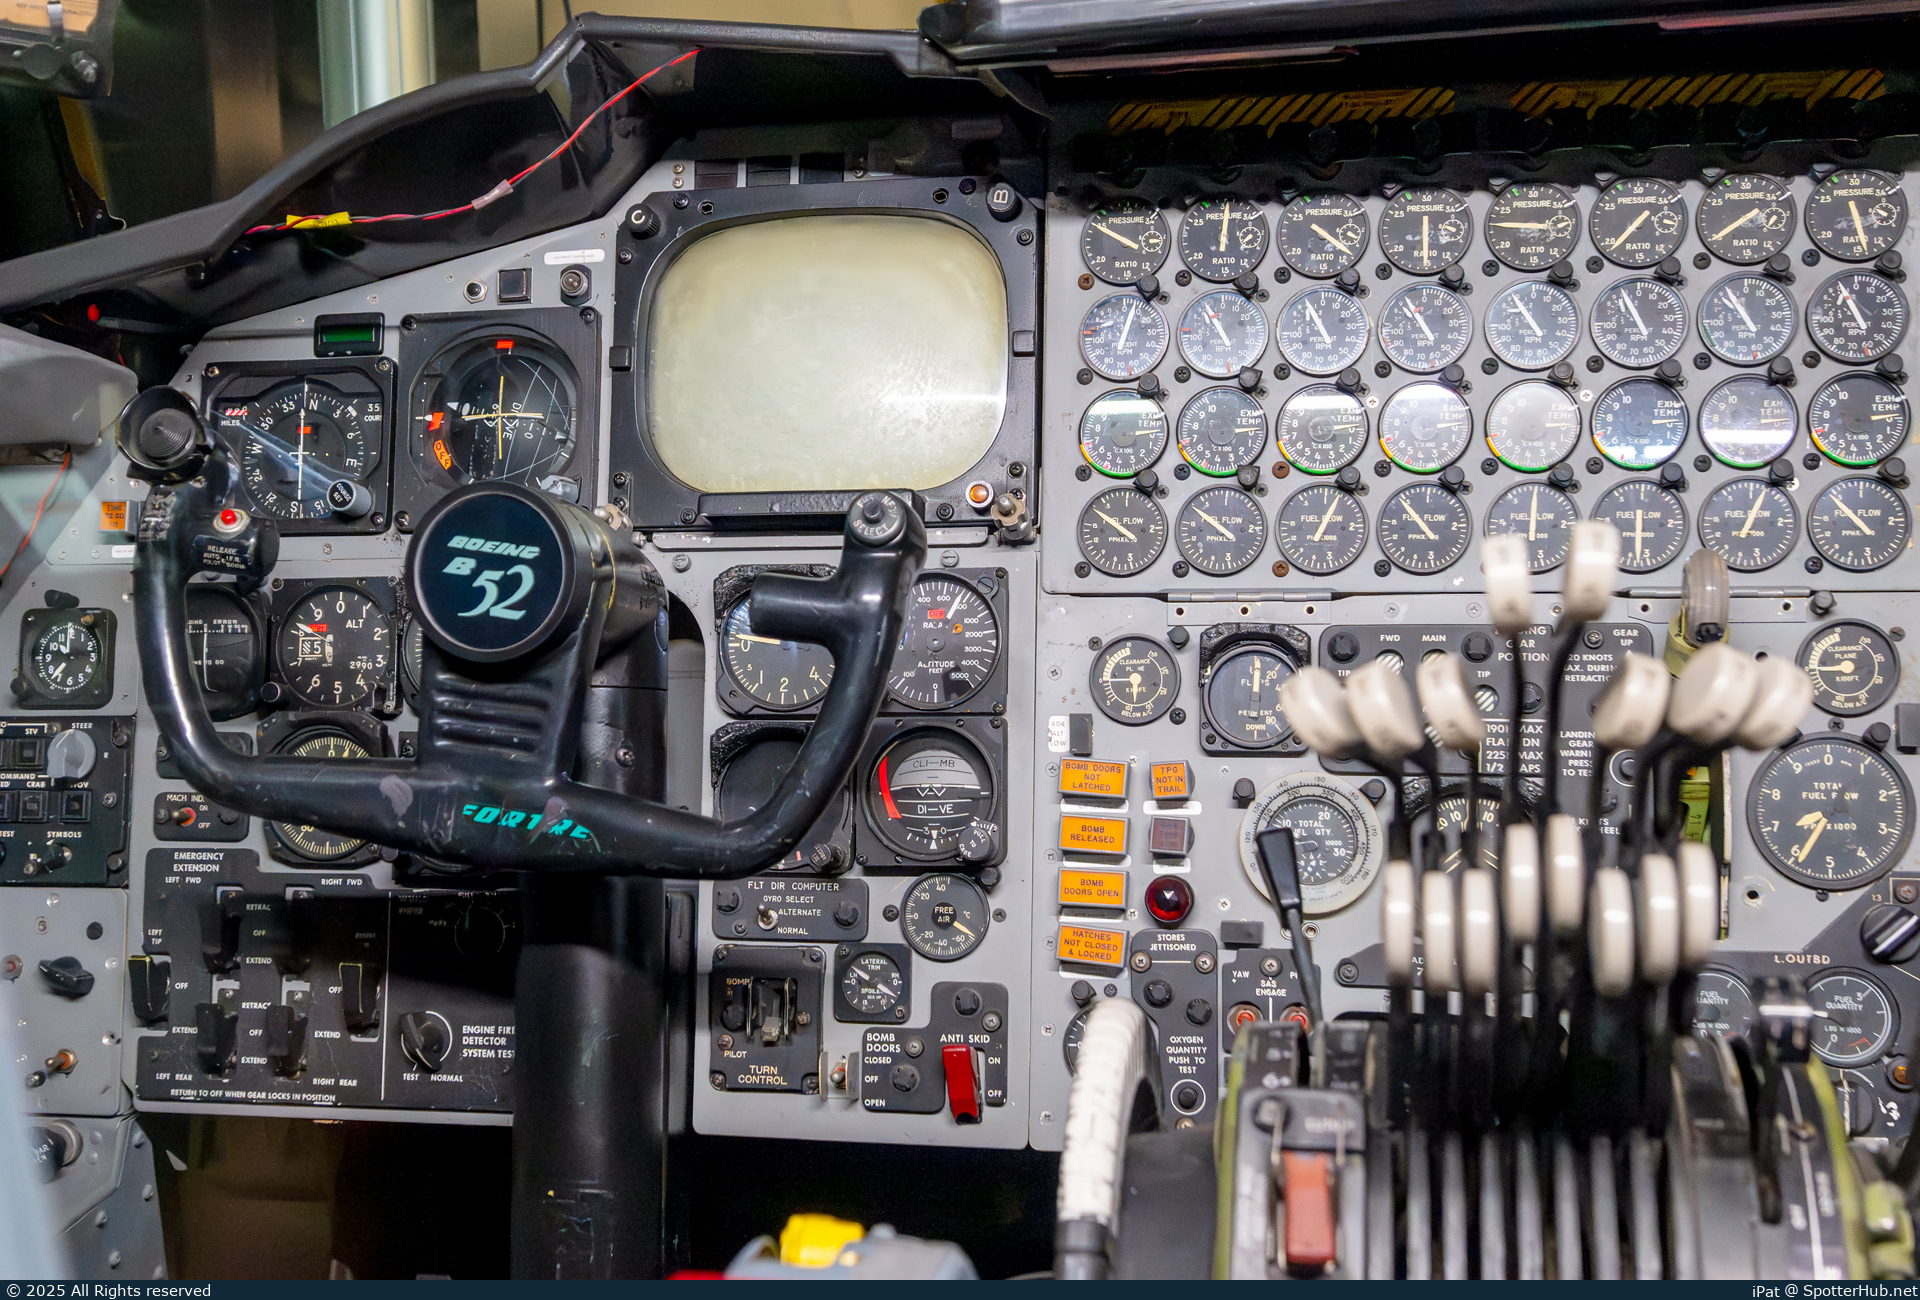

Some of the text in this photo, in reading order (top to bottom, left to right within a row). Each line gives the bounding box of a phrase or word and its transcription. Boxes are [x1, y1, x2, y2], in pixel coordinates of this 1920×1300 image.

[993, 188, 1009, 204] B
[1618, 196, 1657, 204] PRESSURE
[1725, 192, 1765, 200] PRESSURE
[1305, 208, 1342, 216] PRESSURE
[1406, 204, 1443, 213] PRESSURE
[631, 210, 645, 225] C
[1311, 253, 1334, 261] RATIO
[1525, 336, 1542, 344] RPM
[309, 400, 318, 410] N
[1872, 403, 1899, 411] TEMP
[252, 443, 263, 454] W
[434, 443, 452, 468] OFF
[335, 482, 351, 502] COURSE
[332, 493, 343, 503] SET
[290, 502, 299, 512] S
[1858, 509, 1881, 517] FLOW
[1124, 517, 1144, 525] FLOW
[447, 536, 540, 559] BOEING
[442, 556, 535, 621] B 52
[346, 619, 364, 629] ALT
[1613, 629, 1639, 637] GEAR
[964, 645, 982, 653] 3000
[1581, 654, 1613, 662] KNOTS
[1065, 762, 1121, 773] BOMB DOORS
[1160, 766, 1178, 774] TPG
[1084, 773, 1101, 781] NOT
[1156, 775, 1184, 784] NOT IN
[1072, 782, 1111, 792] LATCHED
[1158, 785, 1182, 793] TRAIL
[1319, 811, 1330, 821] 20
[1298, 819, 1324, 827] TOTAL
[1081, 825, 1105, 833] BOMB
[973, 830, 986, 843] PULL
[1070, 833, 1114, 843] RELEASED
[959, 843, 972, 857] CAGE
[174, 852, 224, 861] EMERGENCY
[173, 864, 219, 872] EXTENSION
[165, 876, 201, 884] LEFT FWD
[321, 878, 342, 886] RIGHT
[1080, 879, 1104, 887] BOMB
[792, 883, 839, 891] COMPUTER
[1064, 887, 1120, 898] DOORS OPEN
[778, 927, 808, 935] NORMAL
[1073, 930, 1111, 941] HATCHES
[1064, 939, 1118, 951] NOT CLOSED
[1150, 942, 1196, 951] JETTISONED
[1077, 950, 1112, 961] LOCKED
[175, 982, 188, 990] OFF
[1260, 980, 1277, 988] SAS
[329, 986, 342, 994] OFF
[1255, 988, 1287, 996] ENGAGE
[1826, 1002, 1863, 1010] QUANTITY
[172, 1026, 198, 1034] EXTEND
[463, 1025, 494, 1034] ENGINE
[463, 1036, 506, 1046] DETECTOR
[867, 1033, 895, 1042] BOMB
[940, 1033, 990, 1043] ANTI SKID
[1170, 1036, 1203, 1044] OXYGEN
[866, 1043, 900, 1052] DOORS
[1166, 1046, 1207, 1054] QUANTITY
[462, 1049, 494, 1058] SYSTEM
[241, 1056, 267, 1064] EXTEND
[749, 1066, 778, 1075] TURN
[1178, 1066, 1196, 1074] TEST
[313, 1078, 335, 1086] RIGHT
[431, 1074, 463, 1082] NORMAL
[738, 1075, 787, 1084] CONTROL
[170, 1088, 336, 1101] RETURN TO OFF WHEN GEAR LOCKS IN POSITION
